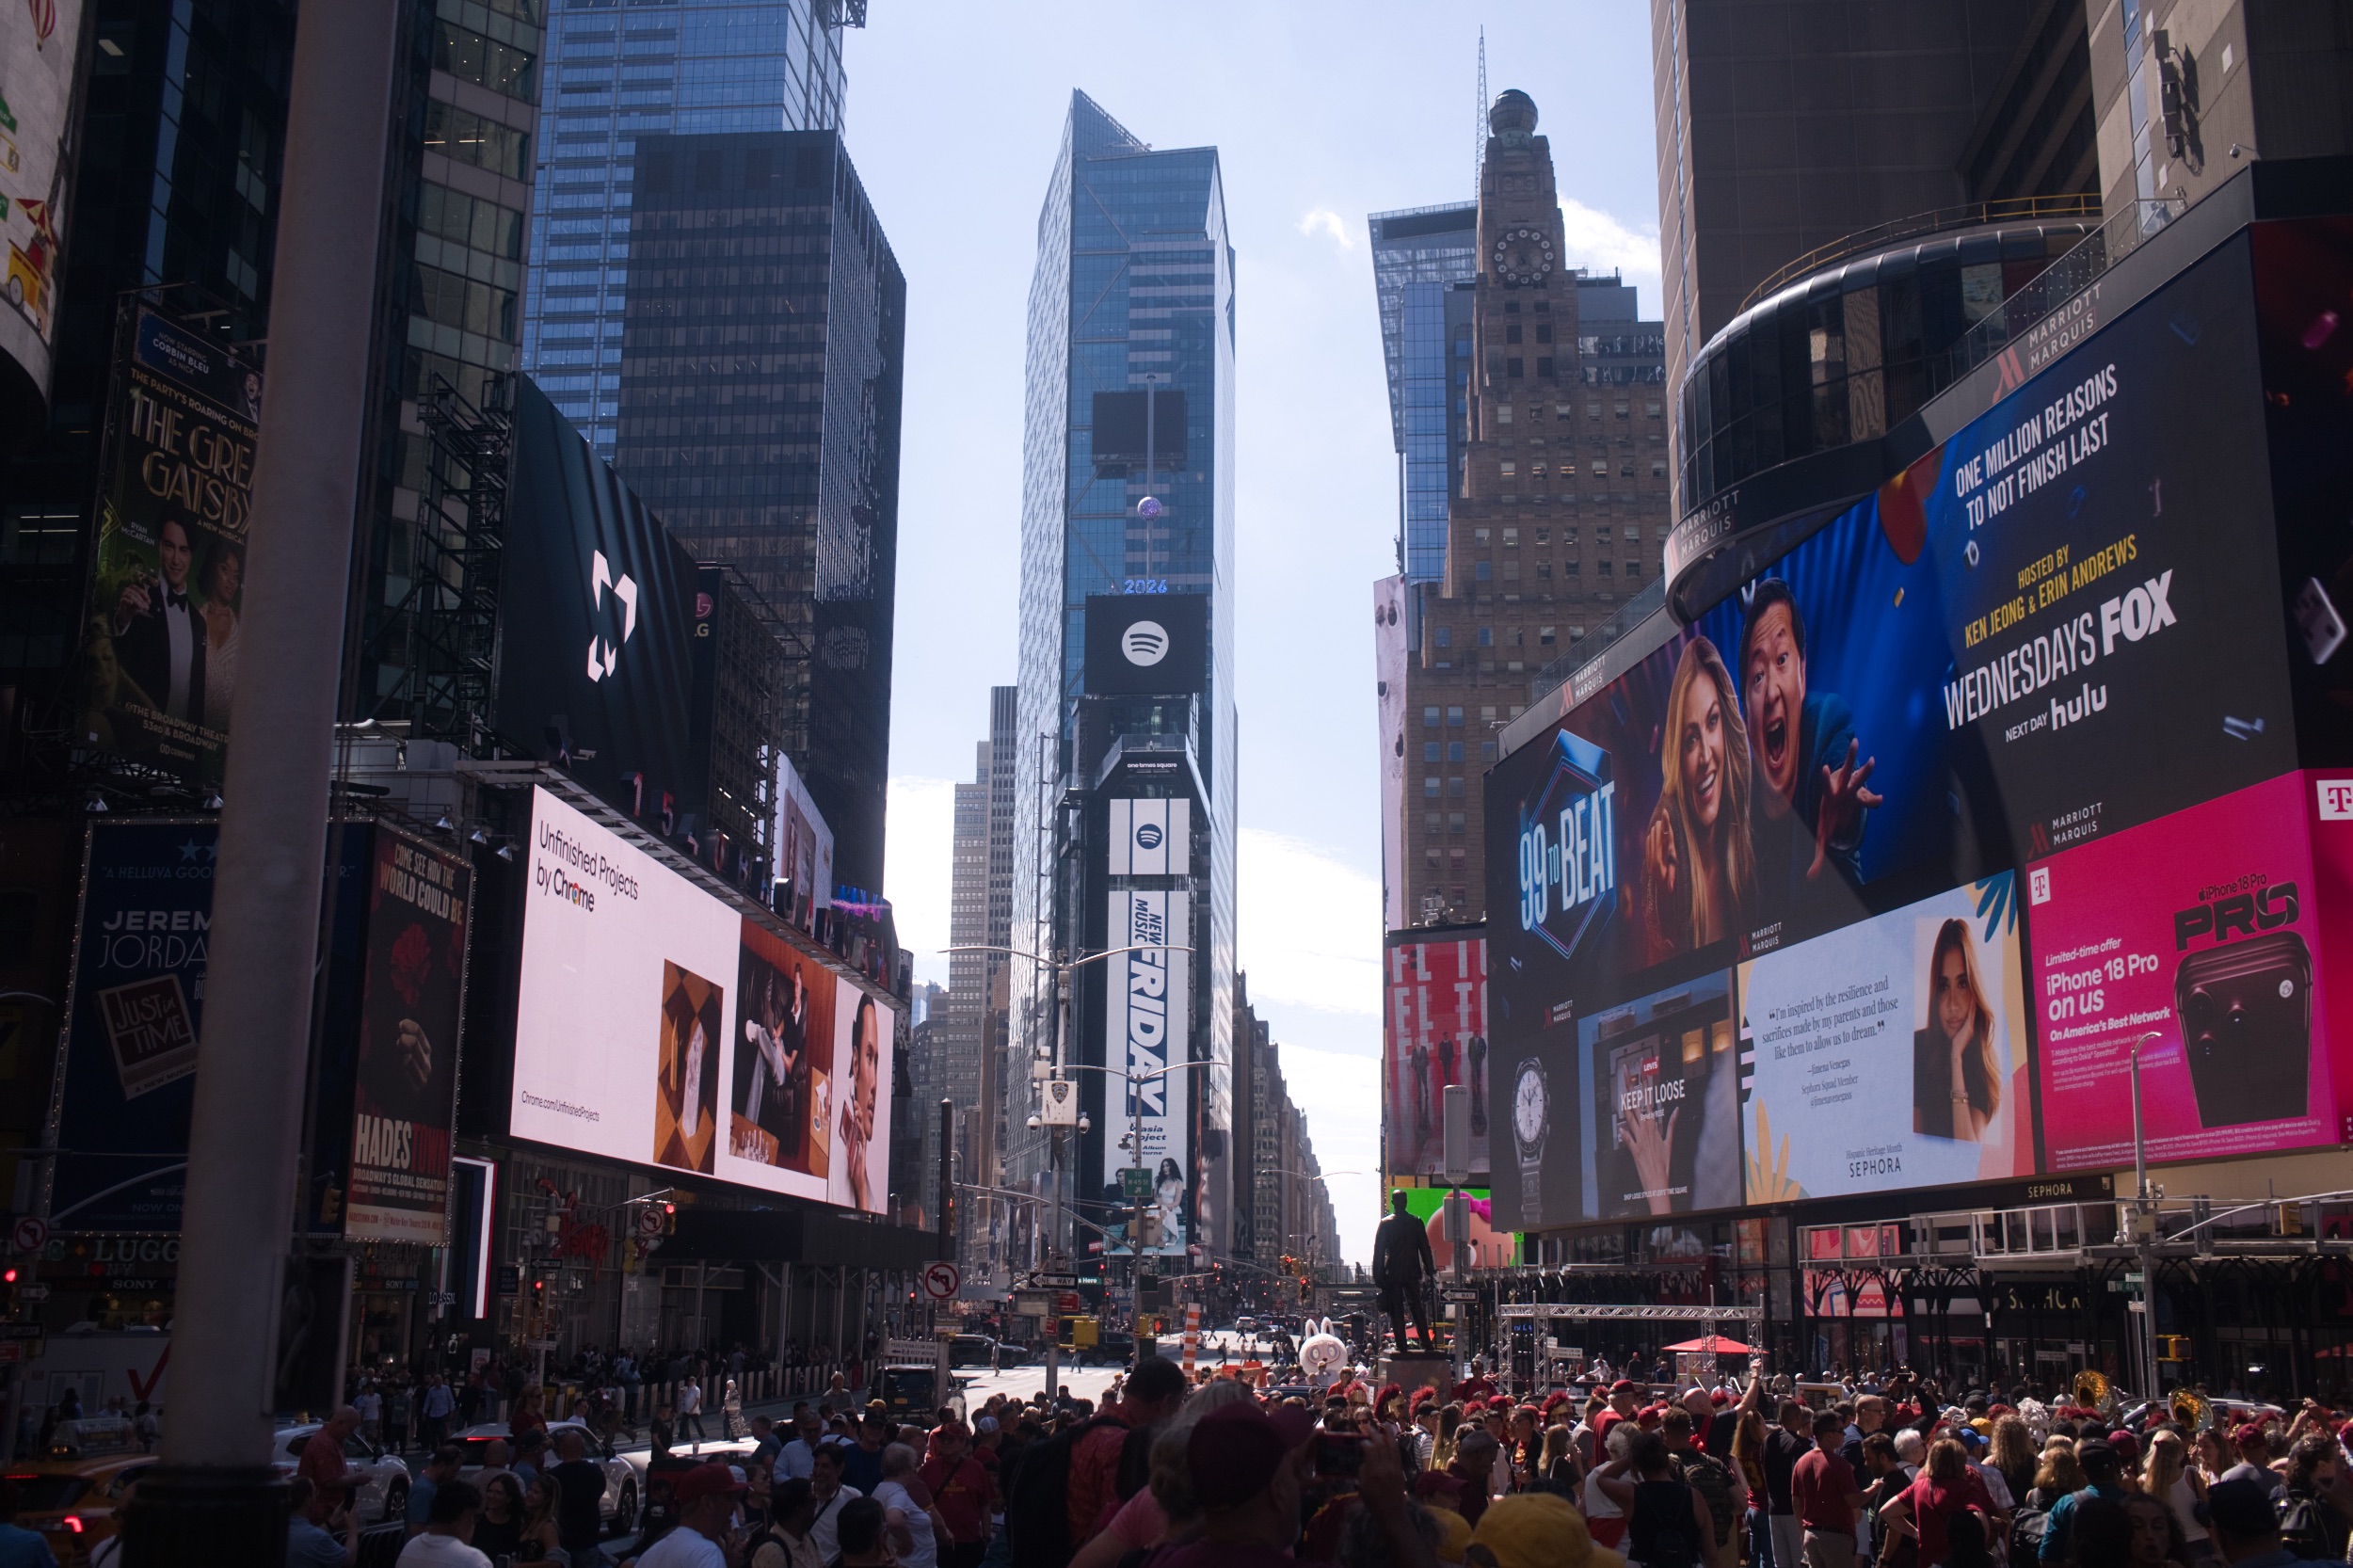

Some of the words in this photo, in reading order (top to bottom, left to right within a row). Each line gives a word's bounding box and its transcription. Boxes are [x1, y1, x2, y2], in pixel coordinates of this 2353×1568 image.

[2029, 283, 2102, 348] MARRIOTT
[152, 338, 186, 361] CORBIN
[188, 359, 209, 375] BLEU
[159, 332, 176, 346] NOW
[177, 341, 207, 363] STARRING
[2030, 313, 2094, 370] MARQUIS
[168, 357, 177, 367] AS
[178, 362, 194, 376] NICK
[131, 367, 149, 385] THE
[151, 379, 187, 405] PARTY'S
[189, 398, 227, 425] ROARING
[229, 419, 241, 433] ON
[131, 393, 184, 456] THE
[189, 425, 255, 491] GRE
[1955, 455, 1983, 498] ONE
[1985, 414, 2041, 480] MILLION
[2045, 363, 2117, 440] REASONS
[1966, 495, 1984, 530] TO
[1988, 474, 2014, 519] NOT
[2018, 439, 2066, 499] FINISH
[2071, 412, 2108, 466] LAST
[131, 521, 147, 535] RYAN
[1680, 490, 1740, 538] MARRIOTT
[121, 526, 155, 546] McCARTAN
[203, 521, 217, 534] NEW
[218, 527, 245, 546] MUSICAL
[1681, 516, 1732, 559] MARQUIS
[2017, 554, 2054, 590] HOSTED
[2056, 544, 2070, 568] BY
[1124, 579, 1167, 594] 2026
[1965, 616, 1987, 648] KEN
[1990, 596, 2025, 636] JEONG
[2028, 595, 2036, 614] &
[2038, 571, 2068, 609] ERIN
[2072, 534, 2137, 592] ANDREWS
[1944, 611, 2096, 731] WEDNESDAYS
[2100, 568, 2177, 656] FOX
[1575, 655, 1606, 686] MARRIOTT
[1576, 672, 1603, 700] MARQUIS
[151, 710, 198, 734] BROADWAY
[2005, 721, 2029, 743] NEXT
[2030, 712, 2048, 732] DAY
[2050, 682, 2107, 731] hulu
[143, 720, 164, 734] 53RD
[165, 727, 171, 737] &
[173, 729, 218, 751] BROADWAY
[2052, 802, 2103, 830] MARRIOTT
[2053, 820, 2098, 845] MARQUIS
[395, 843, 413, 872] COME
[414, 852, 427, 878] SEE
[427, 858, 442, 884] HOW
[443, 865, 455, 890] THE
[540, 820, 597, 877] Unfinished
[599, 856, 639, 900] Projects
[1520, 823, 1548, 931] 99
[1548, 843, 1559, 885] TO
[1561, 780, 1615, 912] BEAT
[380, 861, 416, 904] WORLD
[417, 880, 449, 919] COULD
[450, 897, 464, 926] BE
[537, 858, 552, 896] by
[554, 868, 595, 912] Chrome
[2035, 875, 2045, 898] T
[2205, 882, 2237, 900] iPhone
[2238, 876, 2249, 891] 18
[2250, 873, 2267, 888] Pro
[102, 911, 213, 931] JEREM
[1134, 898, 1148, 942] MUSIC
[1148, 913, 1162, 946] NEW
[1752, 922, 1782, 940] MARRIOTT
[2173, 881, 2299, 952] PRO
[1752, 936, 1779, 953] MARQUIS
[2046, 945, 2099, 967] Limited-time
[2100, 937, 2122, 952] offer
[2046, 968, 2102, 996] iPhone
[2104, 957, 2125, 981] 18
[2128, 953, 2159, 977] Pro
[115, 993, 163, 1031] JUST
[1788, 997, 1815, 1018] inspired
[1816, 995, 1824, 1011] by
[1825, 992, 1837, 1006] the
[1838, 984, 1873, 1003] resilience
[1874, 975, 1889, 993] and
[2048, 995, 2074, 1021] on
[2079, 989, 2105, 1015] us
[1130, 944, 1166, 1117] FRIDAY
[1762, 1026, 1792, 1044] sacrifices
[1793, 1020, 1811, 1036] made
[1812, 1016, 1821, 1033] by
[1822, 1015, 1832, 1030] my
[1834, 1008, 1861, 1028] parents
[1862, 1000, 1876, 1017] and
[1877, 996, 1899, 1013] those
[2050, 1030, 2063, 1042] On
[2063, 1020, 2107, 1040] America's
[2108, 1015, 2128, 1030] Best
[2129, 1007, 2171, 1026] Network
[1774, 1046, 1786, 1060] like
[1787, 1041, 1805, 1058] them
[1806, 1041, 1813, 1053] to
[1814, 1036, 1832, 1051] allow
[1833, 1034, 1841, 1046] us
[1842, 1031, 1850, 1043] to
[1620, 1089, 1643, 1112] KEEP
[1644, 1086, 1654, 1106] IT
[1655, 1079, 1686, 1103] LOOSE
[354, 1113, 449, 1176] HADESTOWN
[1126, 1133, 1167, 1142] Poject
[353, 1168, 392, 1183] BROADWAY'S
[392, 1173, 415, 1188] GLOBAL
[416, 1177, 446, 1191] SENSATION
[1849, 1157, 1901, 1178] SEPHORA
[2027, 1182, 2072, 1199] SEPHORA
[132, 1204, 164, 1212] NOW
[112, 1280, 158, 1289] SONY
[385, 1280, 404, 1289] SONY
[439, 1292, 456, 1305] ASSN.
[957, 1301, 973, 1310] TIMES
